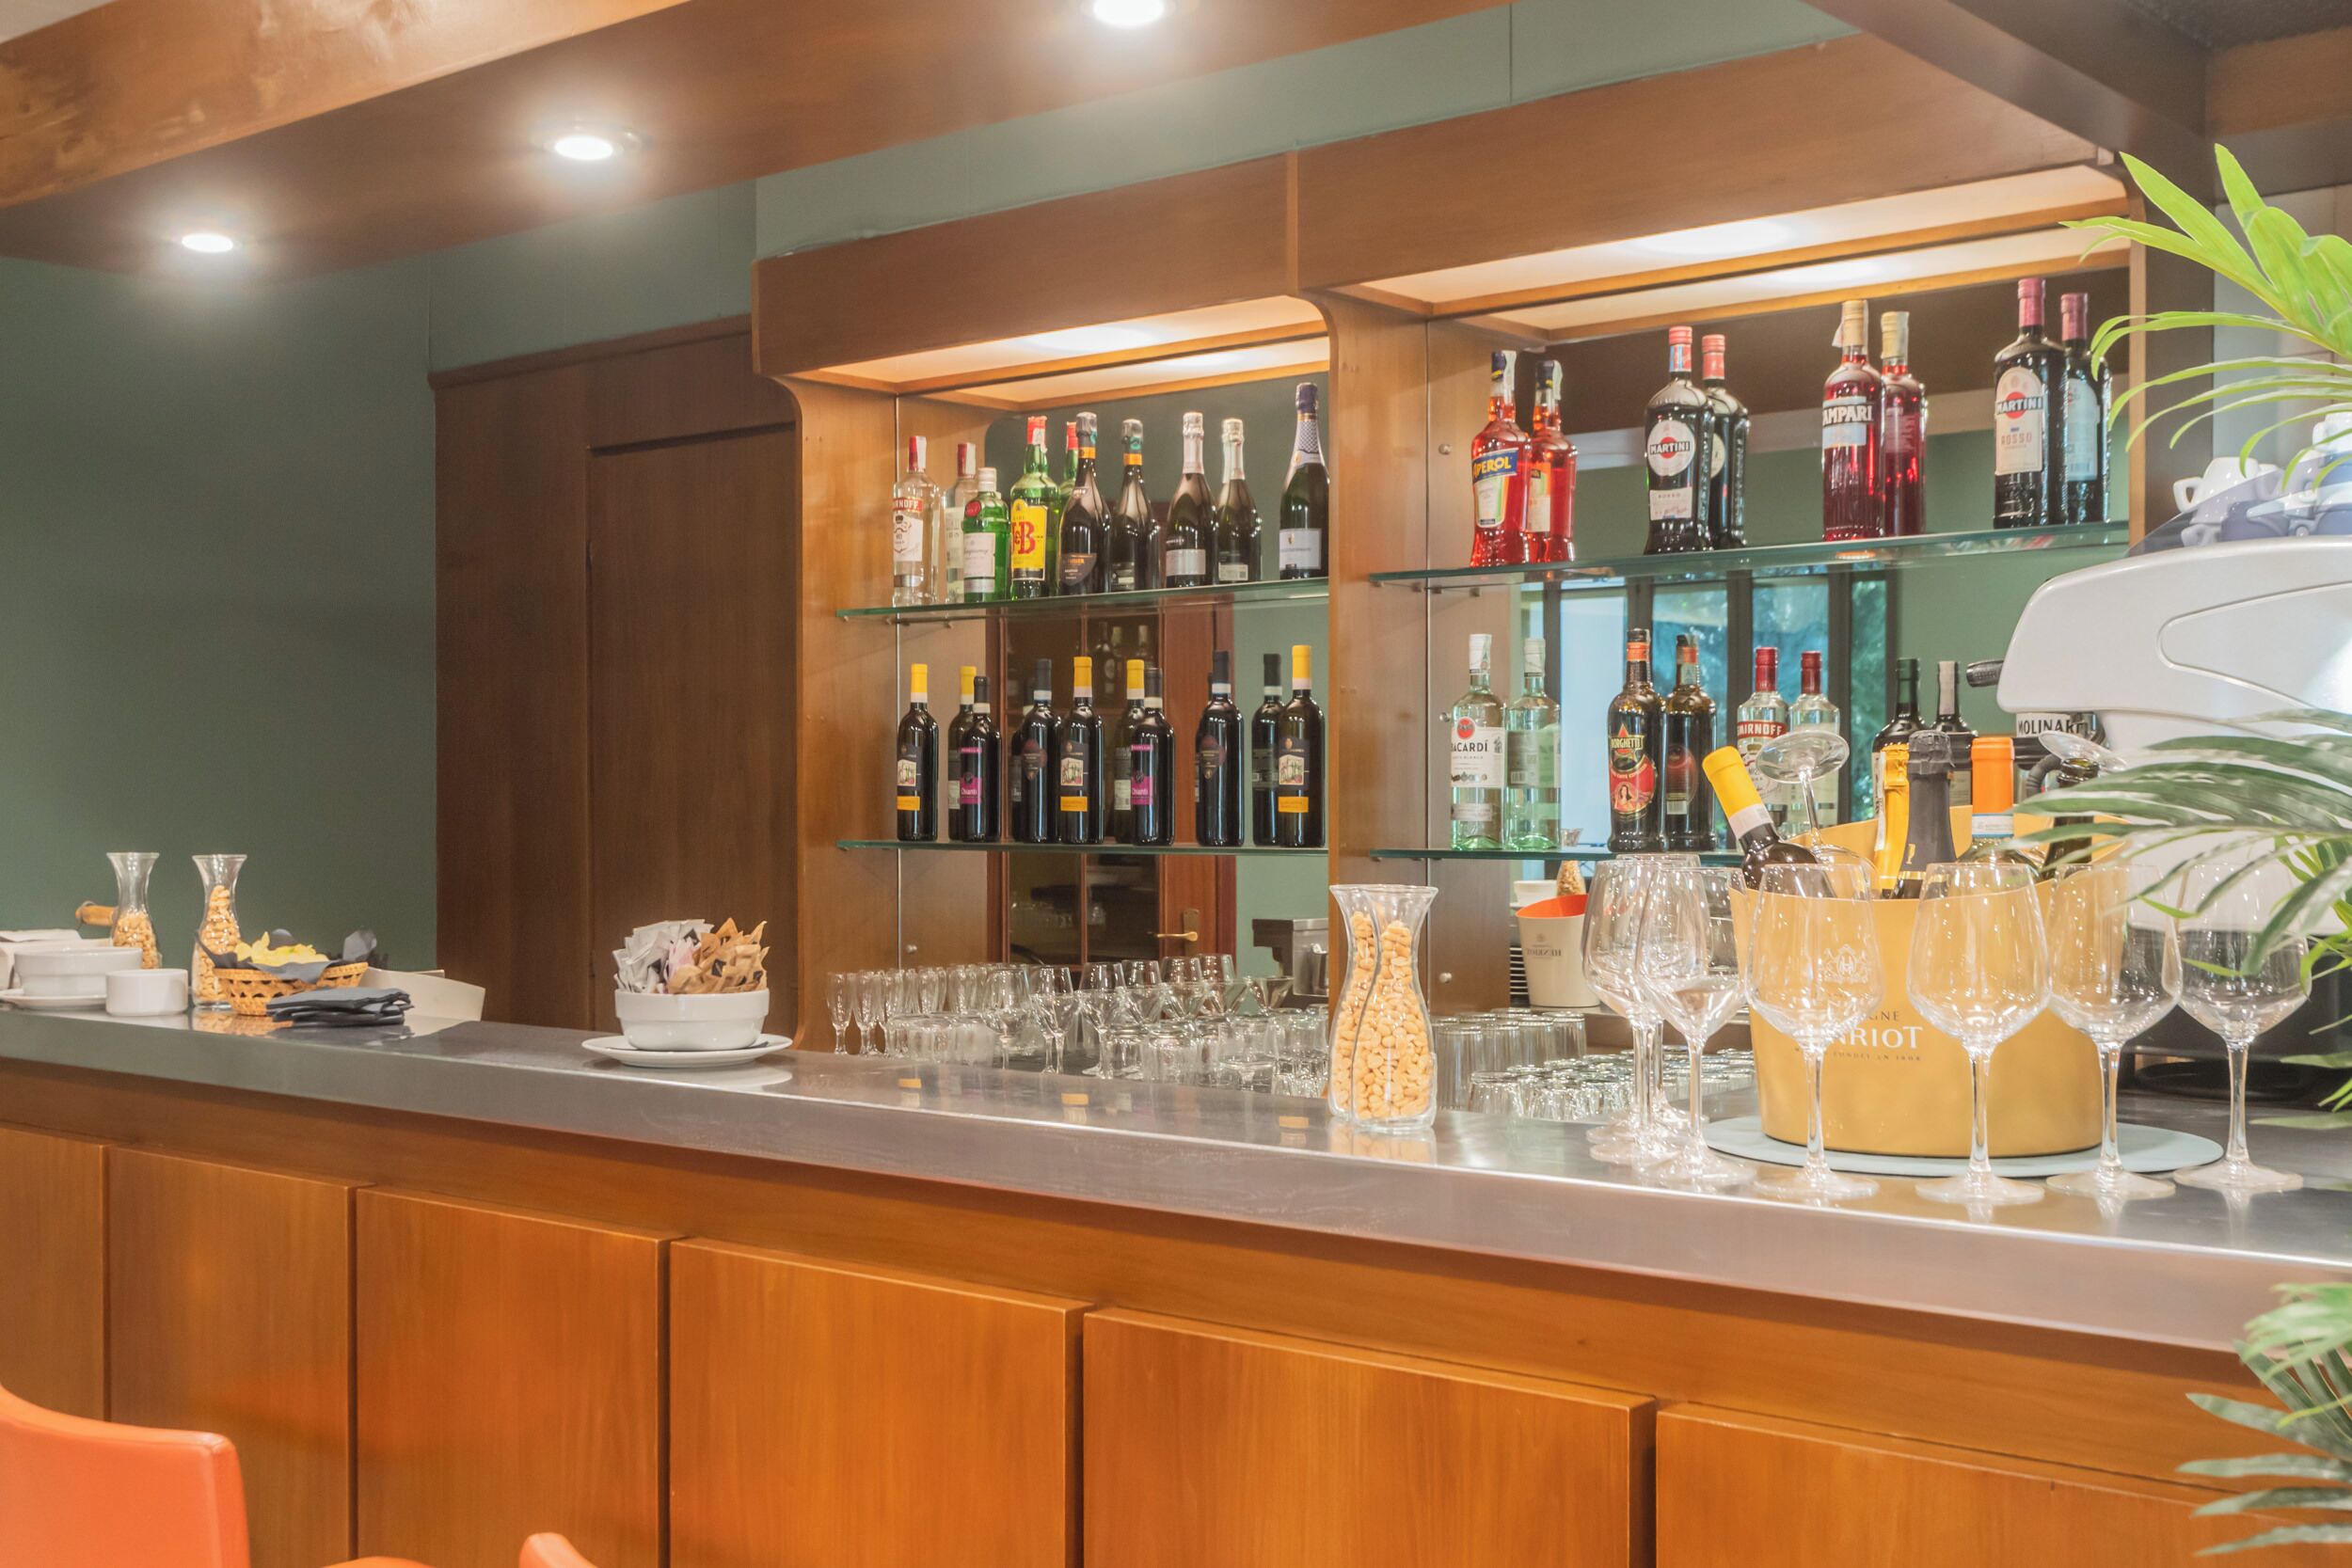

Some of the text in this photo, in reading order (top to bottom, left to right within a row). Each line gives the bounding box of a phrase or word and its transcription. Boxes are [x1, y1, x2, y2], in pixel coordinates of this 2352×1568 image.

[1996, 396, 2042, 415] MARTINI
[1822, 404, 1873, 427] AMPARI
[2000, 433, 2033, 445] ROSSO
[1650, 441, 1691, 454] MARTINI
[894, 499, 919, 509] RNOFF
